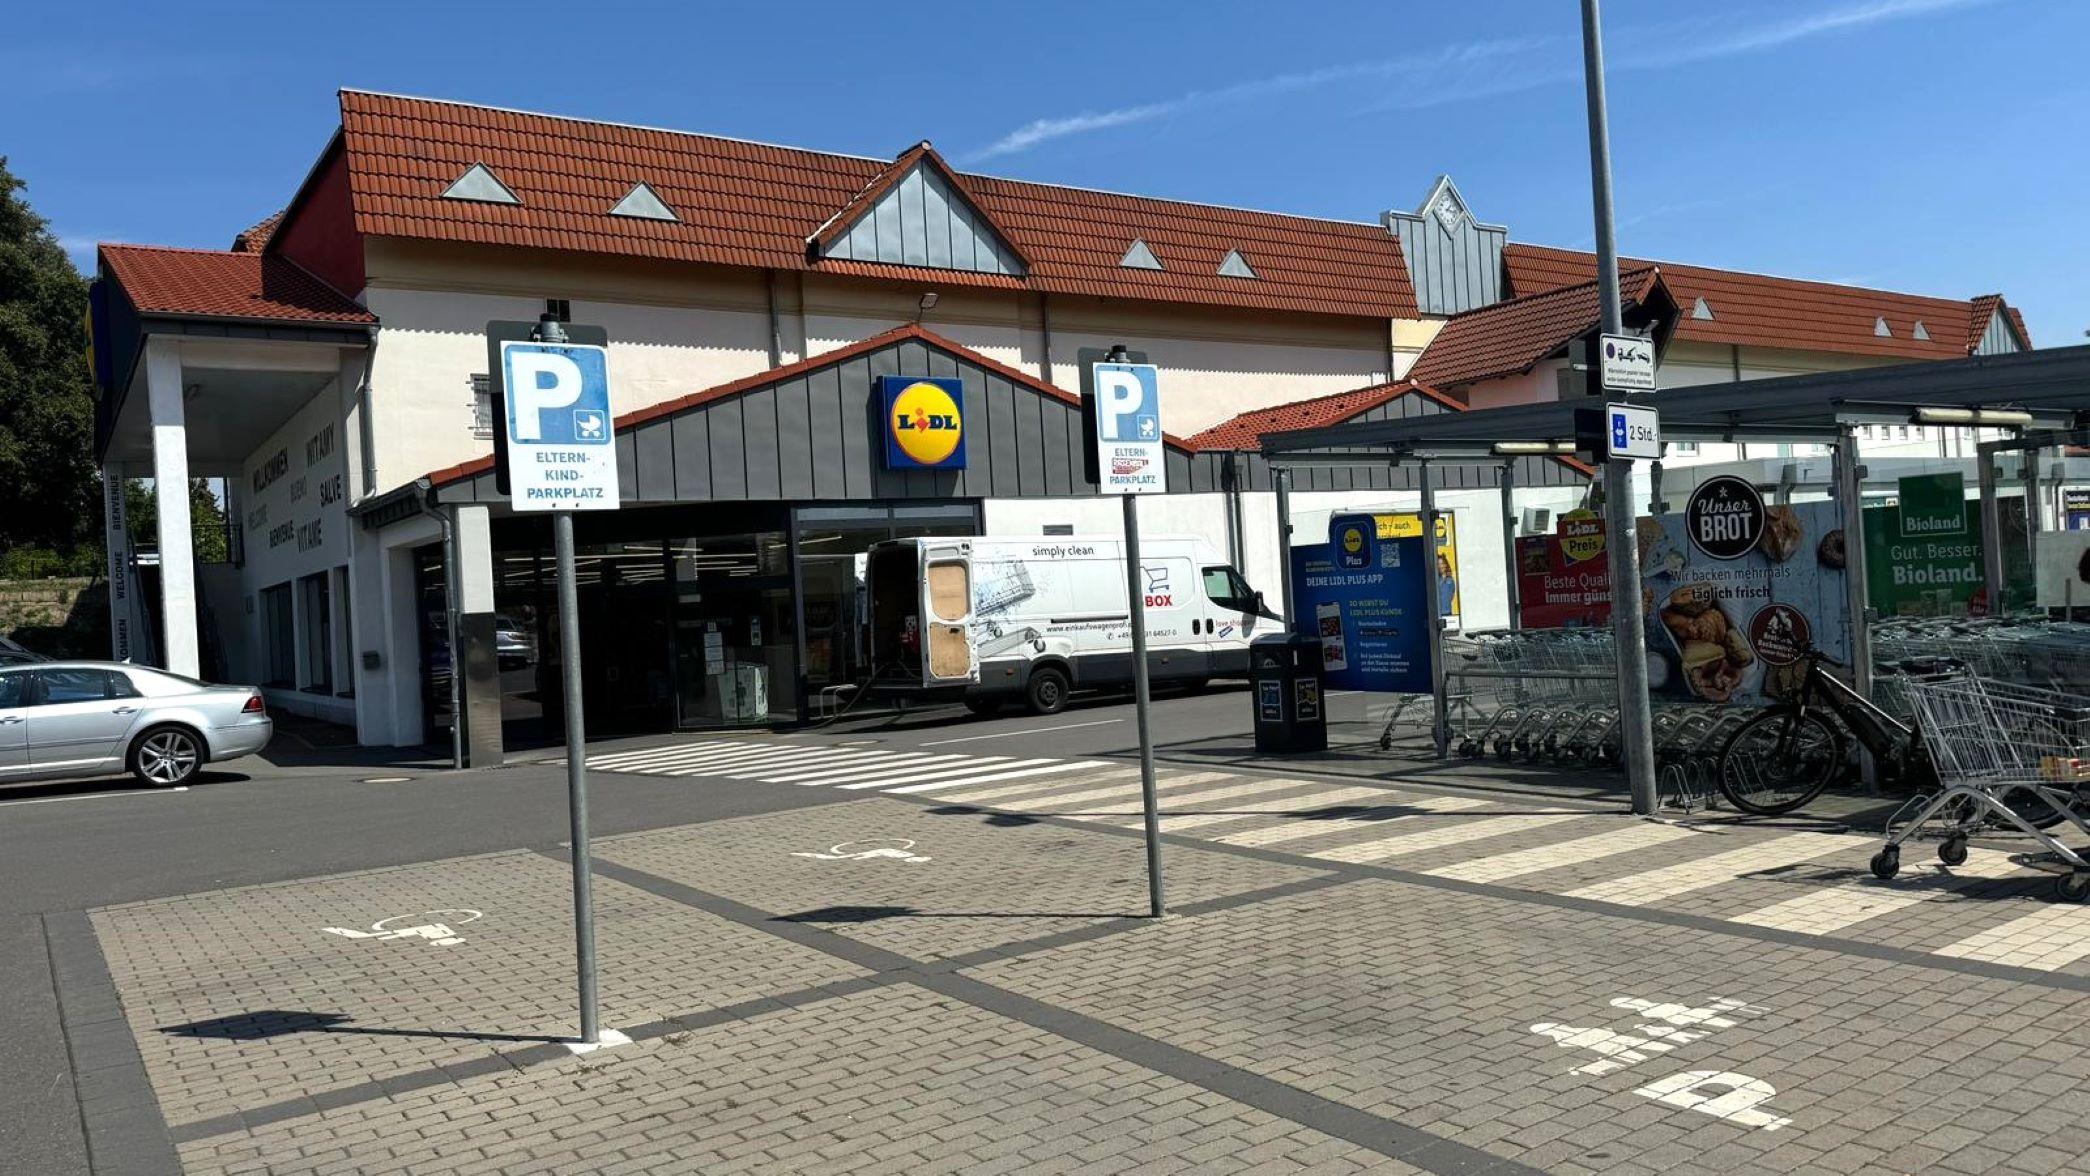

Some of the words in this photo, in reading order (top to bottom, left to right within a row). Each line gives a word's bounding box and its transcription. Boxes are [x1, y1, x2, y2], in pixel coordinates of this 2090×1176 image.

[511, 351, 583, 440] P
[1098, 370, 1143, 439] P
[897, 407, 957, 433] LIDL
[1629, 426, 1635, 441] 2
[536, 452, 590, 464] ELTERN-
[1114, 447, 1149, 457] ELTERN-
[545, 470, 584, 481] KIND-
[1109, 475, 1156, 486] PARKPLATZ
[320, 472, 341, 508] SALVE
[527, 487, 604, 499] PARKPLATZ
[110, 474, 122, 531] BIENVENUE
[1698, 497, 1753, 515] Unser
[1566, 521, 1600, 536] LIDL
[1699, 512, 1753, 543] BROT
[1905, 514, 1961, 532] Bioland
[1032, 545, 1066, 558] simply
[1068, 545, 1094, 556] clean
[1569, 538, 1597, 553] Preis
[1890, 544, 1923, 561] Gut.
[1927, 543, 1984, 559] Besser.
[1346, 556, 1362, 565] Plus
[115, 551, 125, 600] WELCOME
[1306, 576, 1328, 587] DEINE
[1329, 576, 1346, 586] LIDL
[1347, 575, 1366, 585] PLUS
[1367, 574, 1384, 584] APP
[1544, 575, 1576, 589] Beste
[1579, 572, 1611, 591] Quali
[1671, 569, 1689, 582] Wir
[1692, 568, 1731, 581] backen
[1735, 566, 1790, 580] mehrmals
[1891, 561, 1984, 585] Bioland.
[1545, 590, 1582, 604] Immer
[1583, 589, 1613, 606] güns
[1692, 586, 1733, 603] täglich
[1736, 586, 1771, 599] frisch
